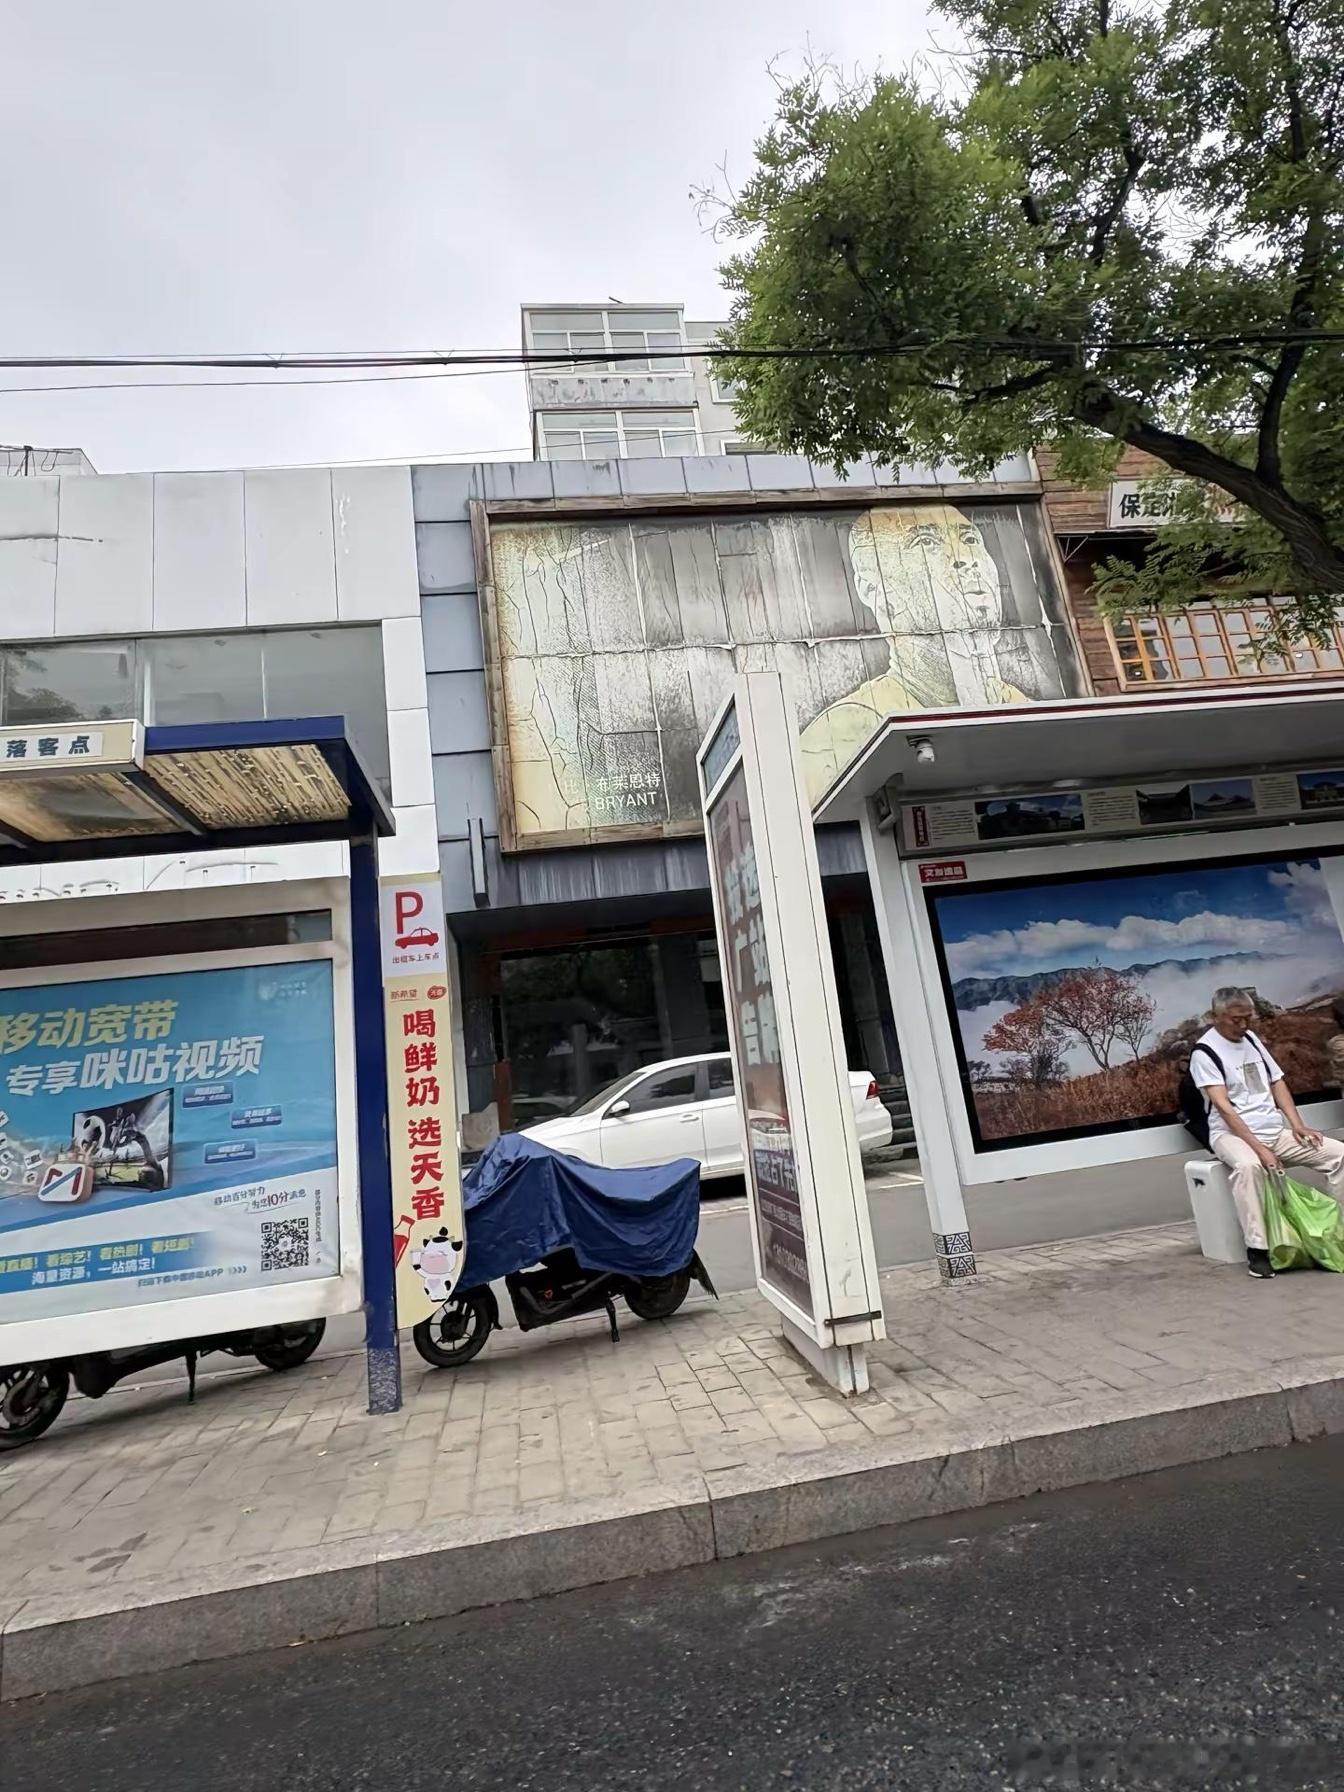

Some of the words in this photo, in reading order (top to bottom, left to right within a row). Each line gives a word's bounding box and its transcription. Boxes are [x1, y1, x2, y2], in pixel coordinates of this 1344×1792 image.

[6, 735, 90, 758] 落客点
[594, 791, 657, 810] BRYANT
[395, 891, 424, 934] P
[0, 999, 179, 1055] 移动宽带
[6, 1035, 264, 1097] 专享咪咕视频
